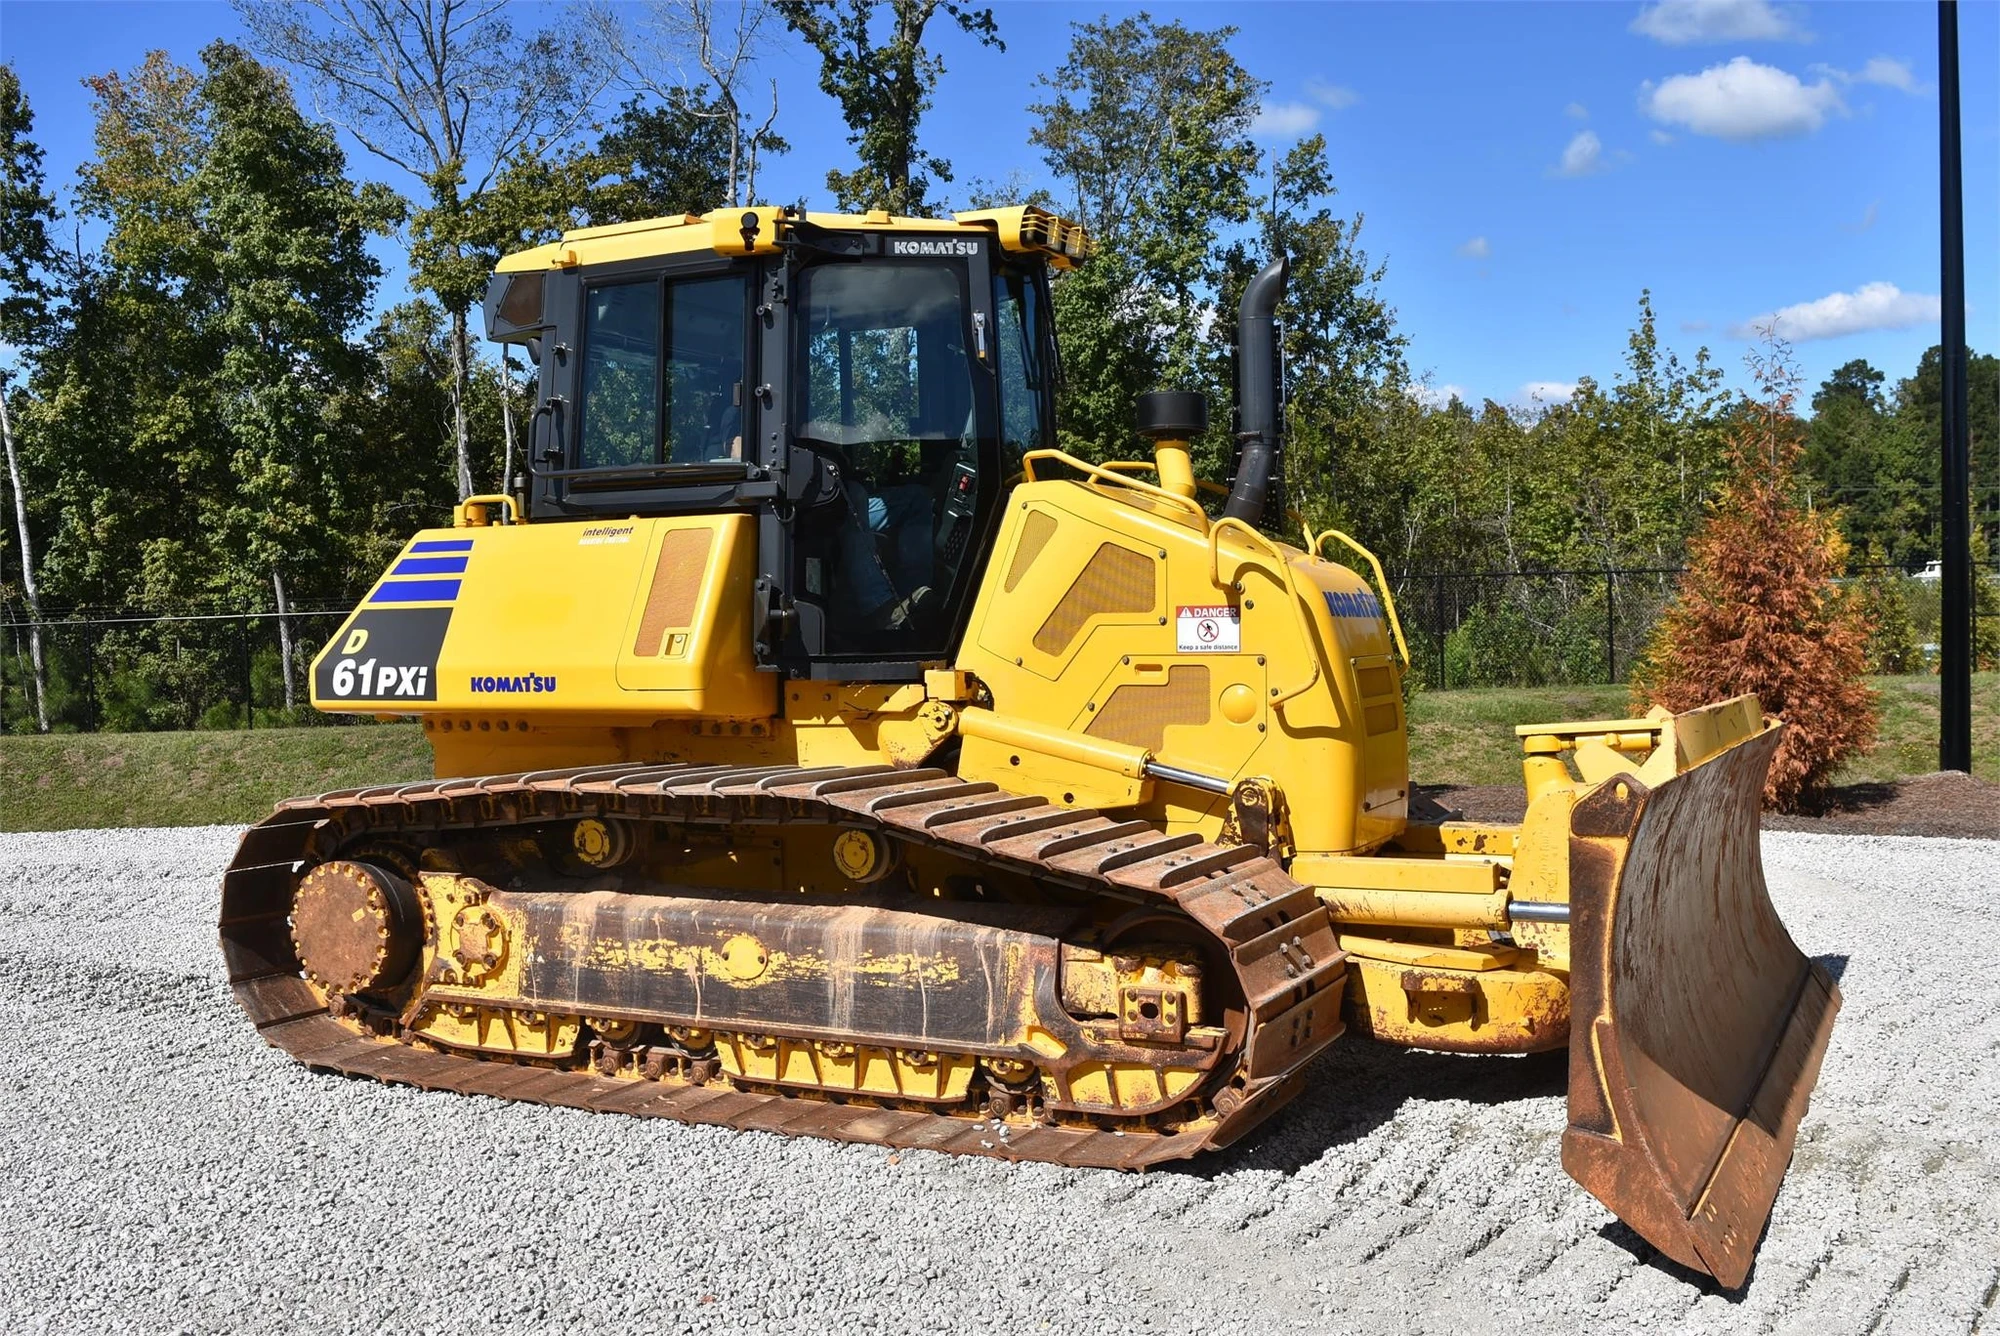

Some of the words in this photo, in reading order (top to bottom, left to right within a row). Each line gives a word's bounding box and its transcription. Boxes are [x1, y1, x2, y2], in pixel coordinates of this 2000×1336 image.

[894, 238, 979, 255] KOMATSU
[582, 526, 634, 537] intelligent
[1193, 607, 1237, 618] DANGER
[1322, 588, 1383, 618] KOMATSU
[341, 629, 369, 654] D
[332, 658, 428, 696] 61PXi
[471, 672, 556, 693] KOMATSU
